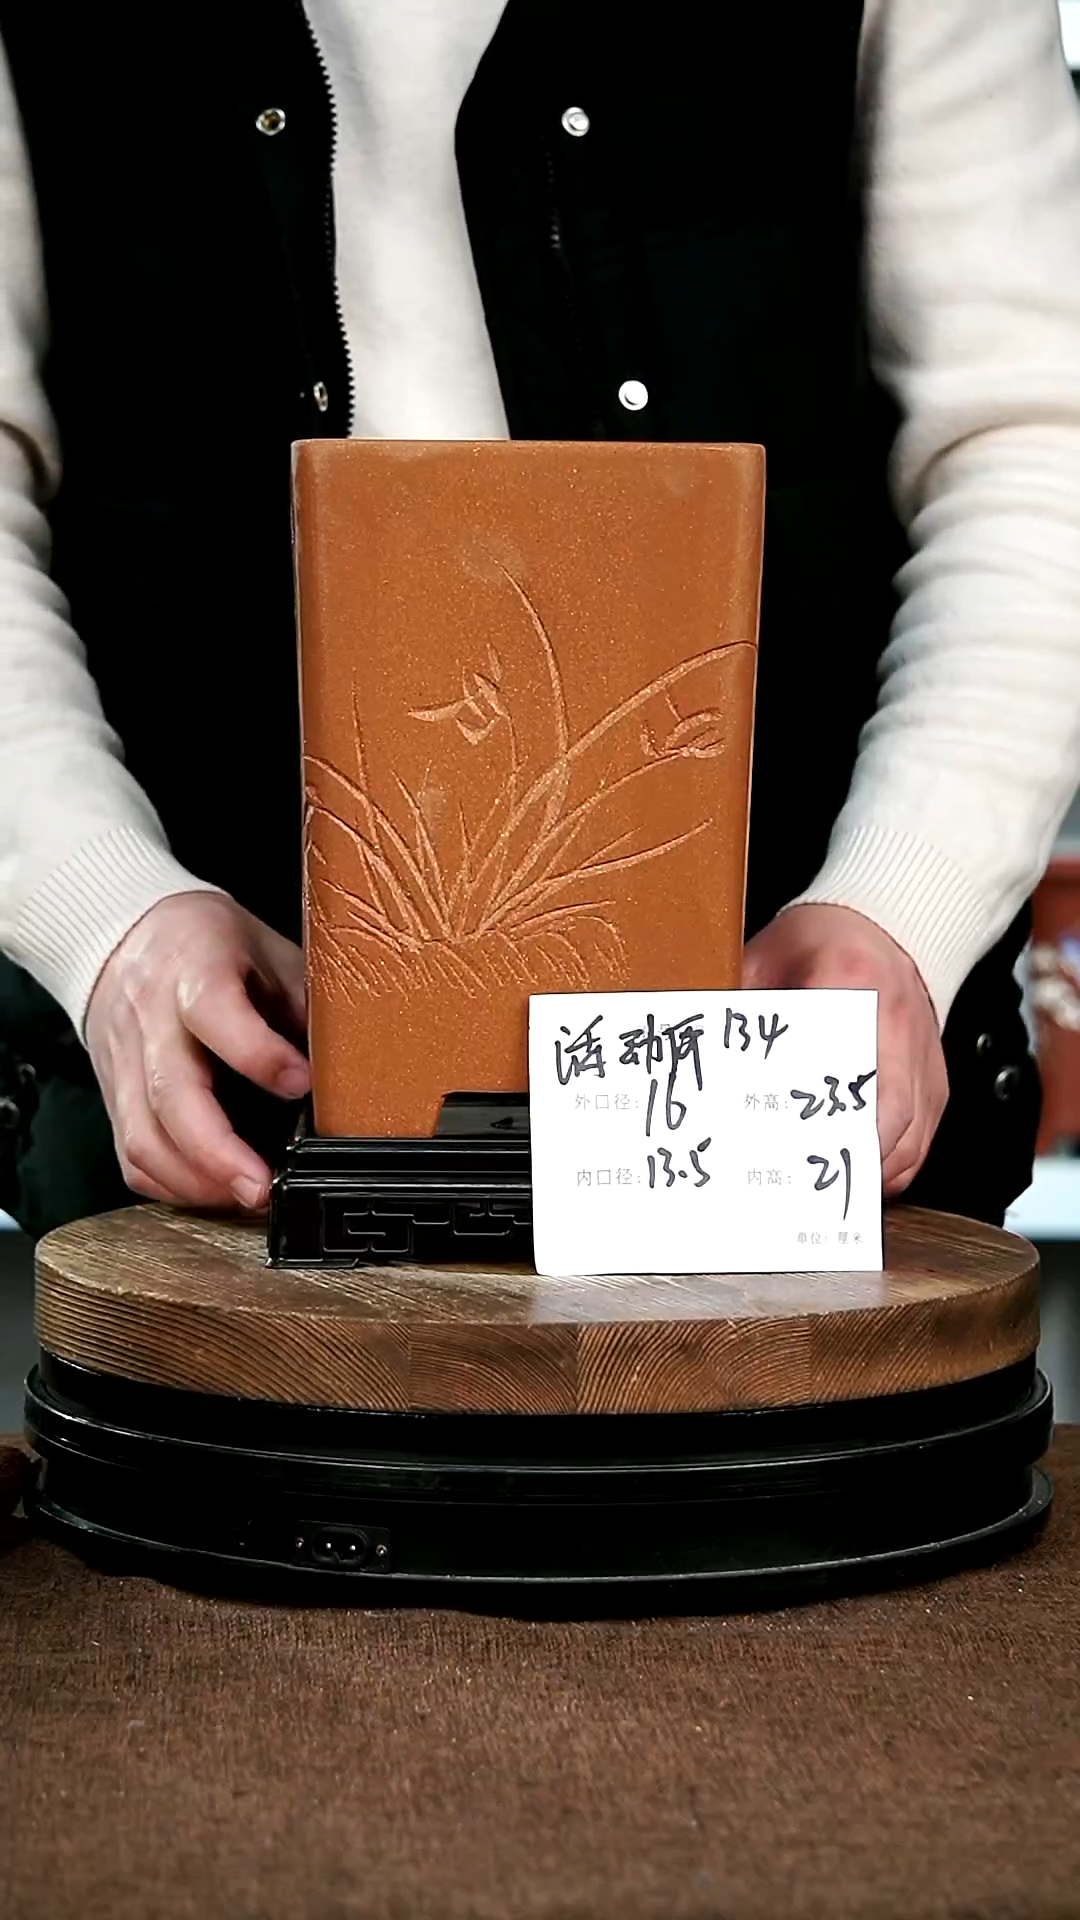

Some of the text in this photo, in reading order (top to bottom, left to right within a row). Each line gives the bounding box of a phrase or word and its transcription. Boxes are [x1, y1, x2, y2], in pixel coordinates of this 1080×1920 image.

[574, 1092, 639, 1111] 外口径:
[645, 1072, 687, 1138] 16
[743, 1092, 789, 1112] 外高:
[646, 1137, 712, 1189] 13.5
[576, 1167, 641, 1187] 内口径:
[747, 1167, 792, 1187] 内高:
[806, 1147, 852, 1221] 21
